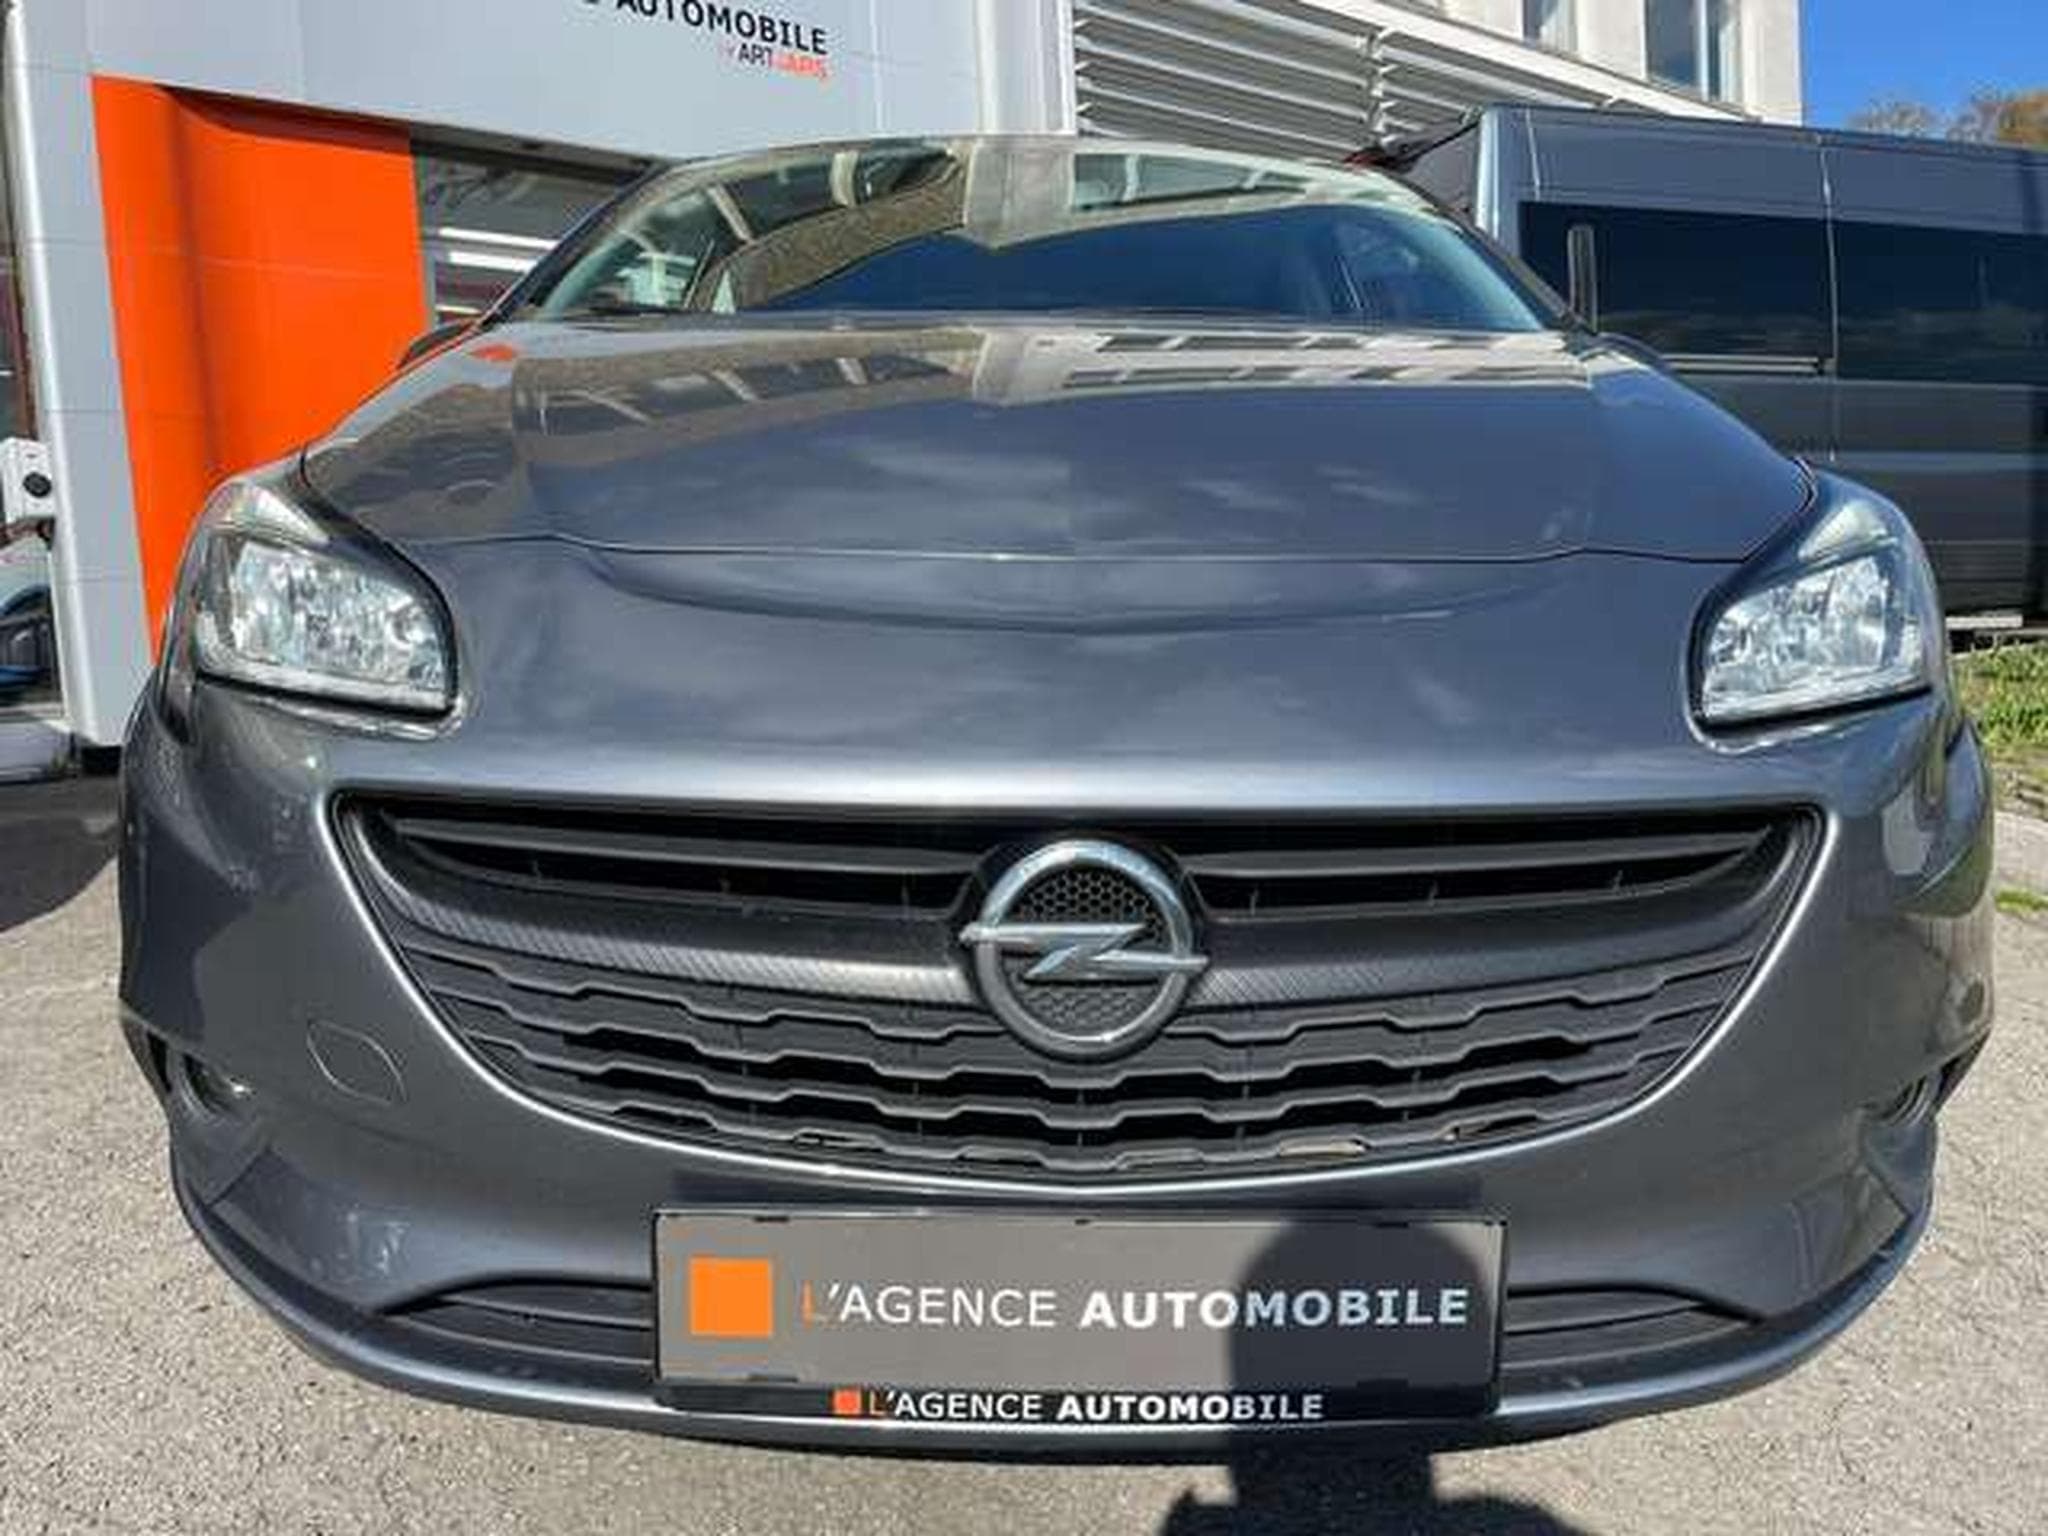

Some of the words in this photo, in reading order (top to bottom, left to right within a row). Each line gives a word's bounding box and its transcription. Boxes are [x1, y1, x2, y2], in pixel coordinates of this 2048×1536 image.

[802, 1281, 1057, 1328] L'AGENCE
[1080, 1289, 1468, 1329] AUTOMOBILE
[869, 1391, 1043, 1420] L'AGENCE
[1056, 1394, 1323, 1421] AUTOMOBILE
